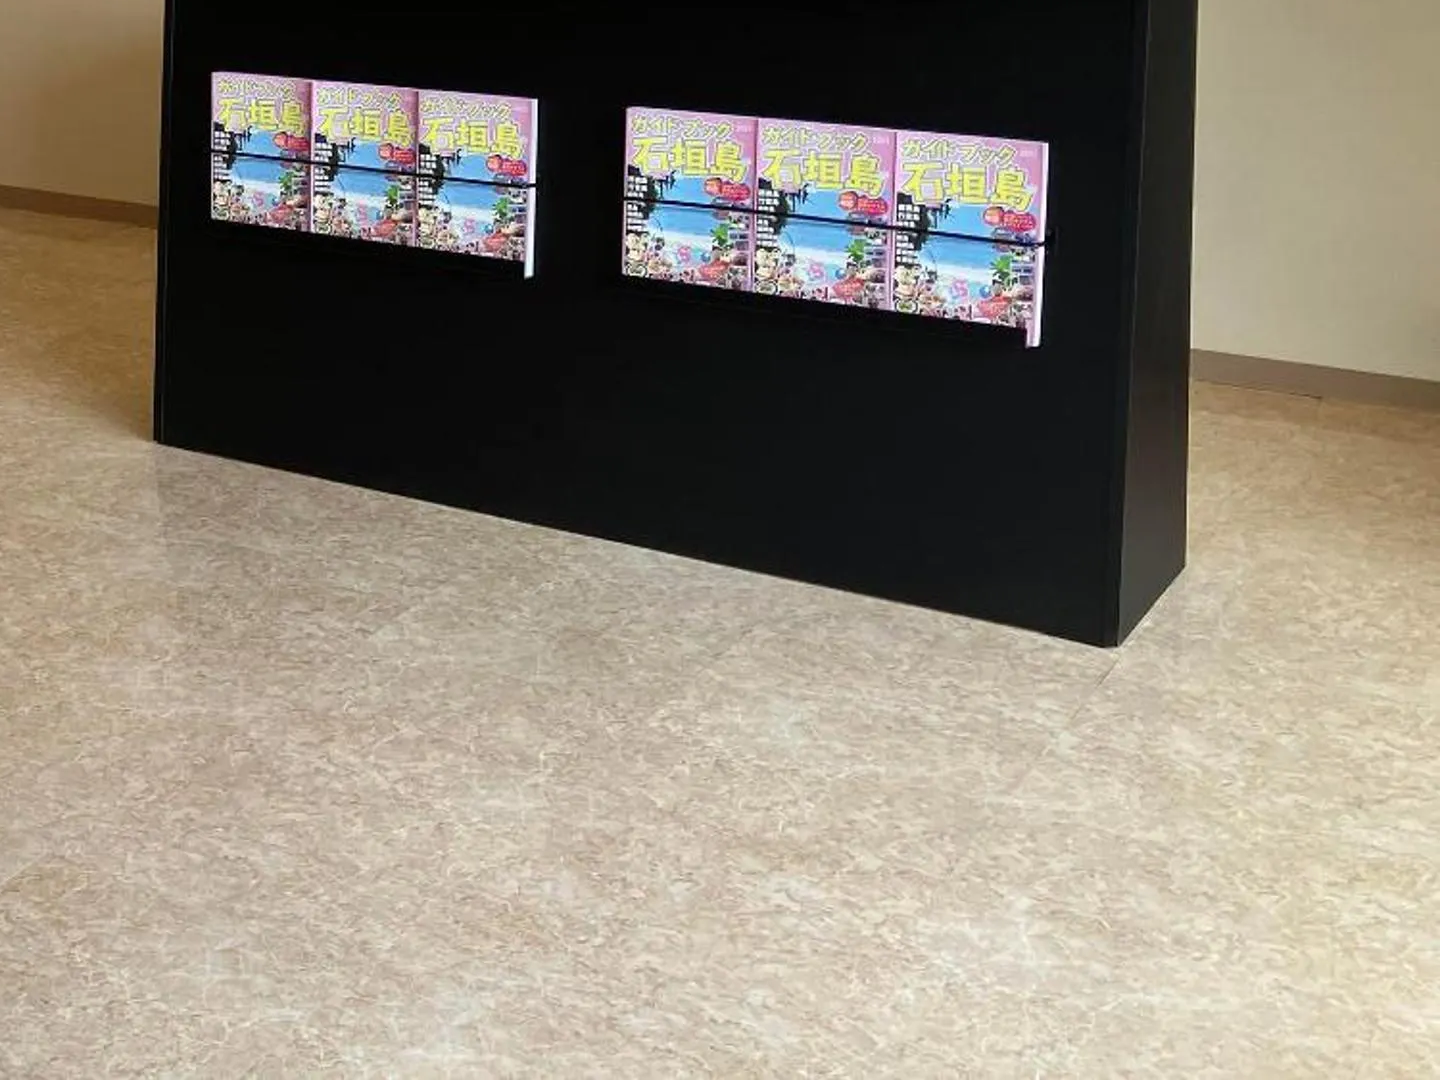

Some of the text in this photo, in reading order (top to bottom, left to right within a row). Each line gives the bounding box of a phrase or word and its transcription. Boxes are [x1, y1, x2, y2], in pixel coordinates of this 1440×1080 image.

[218, 97, 305, 137] 石垣島
[318, 107, 414, 147] 石垣島
[420, 117, 522, 159] 石垣島
[632, 136, 747, 182] 石垣島
[762, 149, 884, 198] 石垣島
[903, 162, 1033, 212] 石垣島
